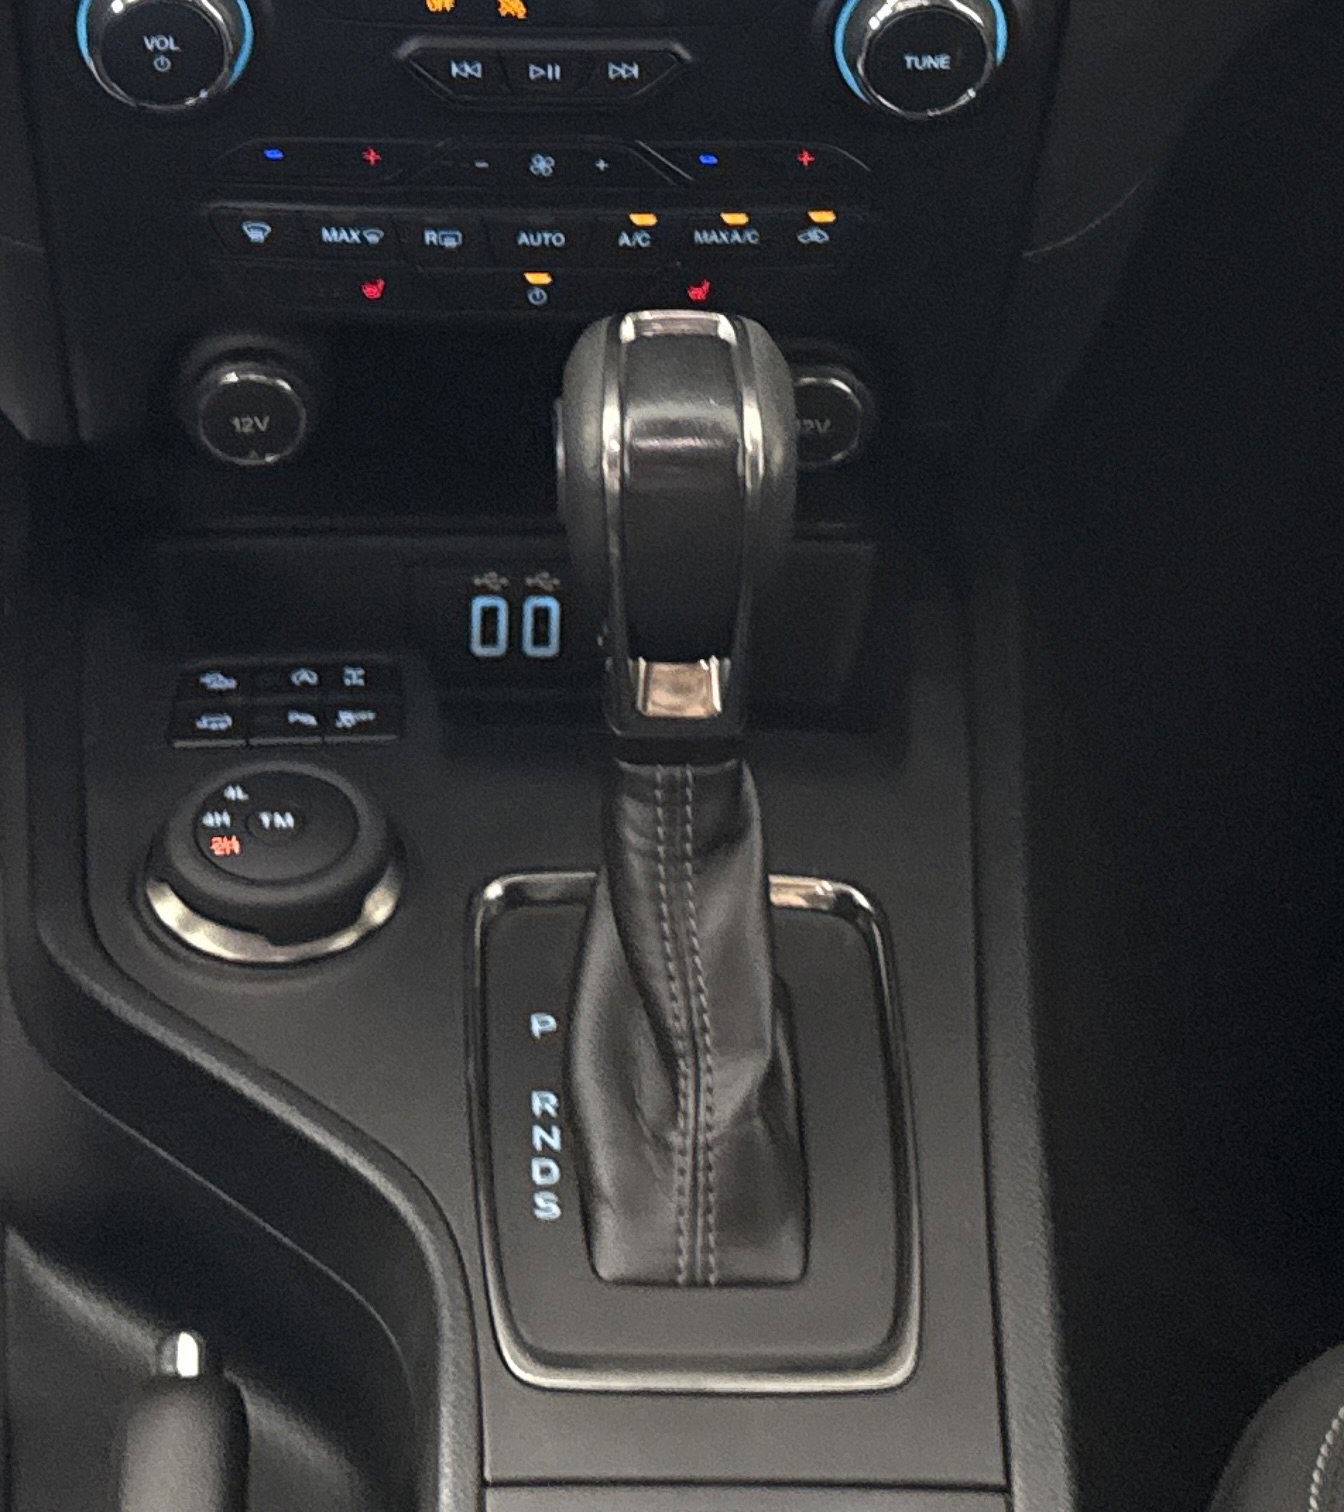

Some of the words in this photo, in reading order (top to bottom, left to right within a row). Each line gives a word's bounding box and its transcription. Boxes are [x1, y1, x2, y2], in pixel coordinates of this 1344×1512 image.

[143, 35, 181, 52] VOL
[904, 53, 951, 71] TUNE
[320, 226, 361, 244] MAX
[517, 230, 566, 248] AUTO
[618, 230, 652, 248] A/C
[230, 415, 270, 433] 12V
[259, 811, 295, 830] TM
[529, 1012, 557, 1039] P
[530, 1090, 558, 1117] R
[532, 1125, 562, 1152] N
[531, 1157, 561, 1185] D
[532, 1191, 562, 1220] S
